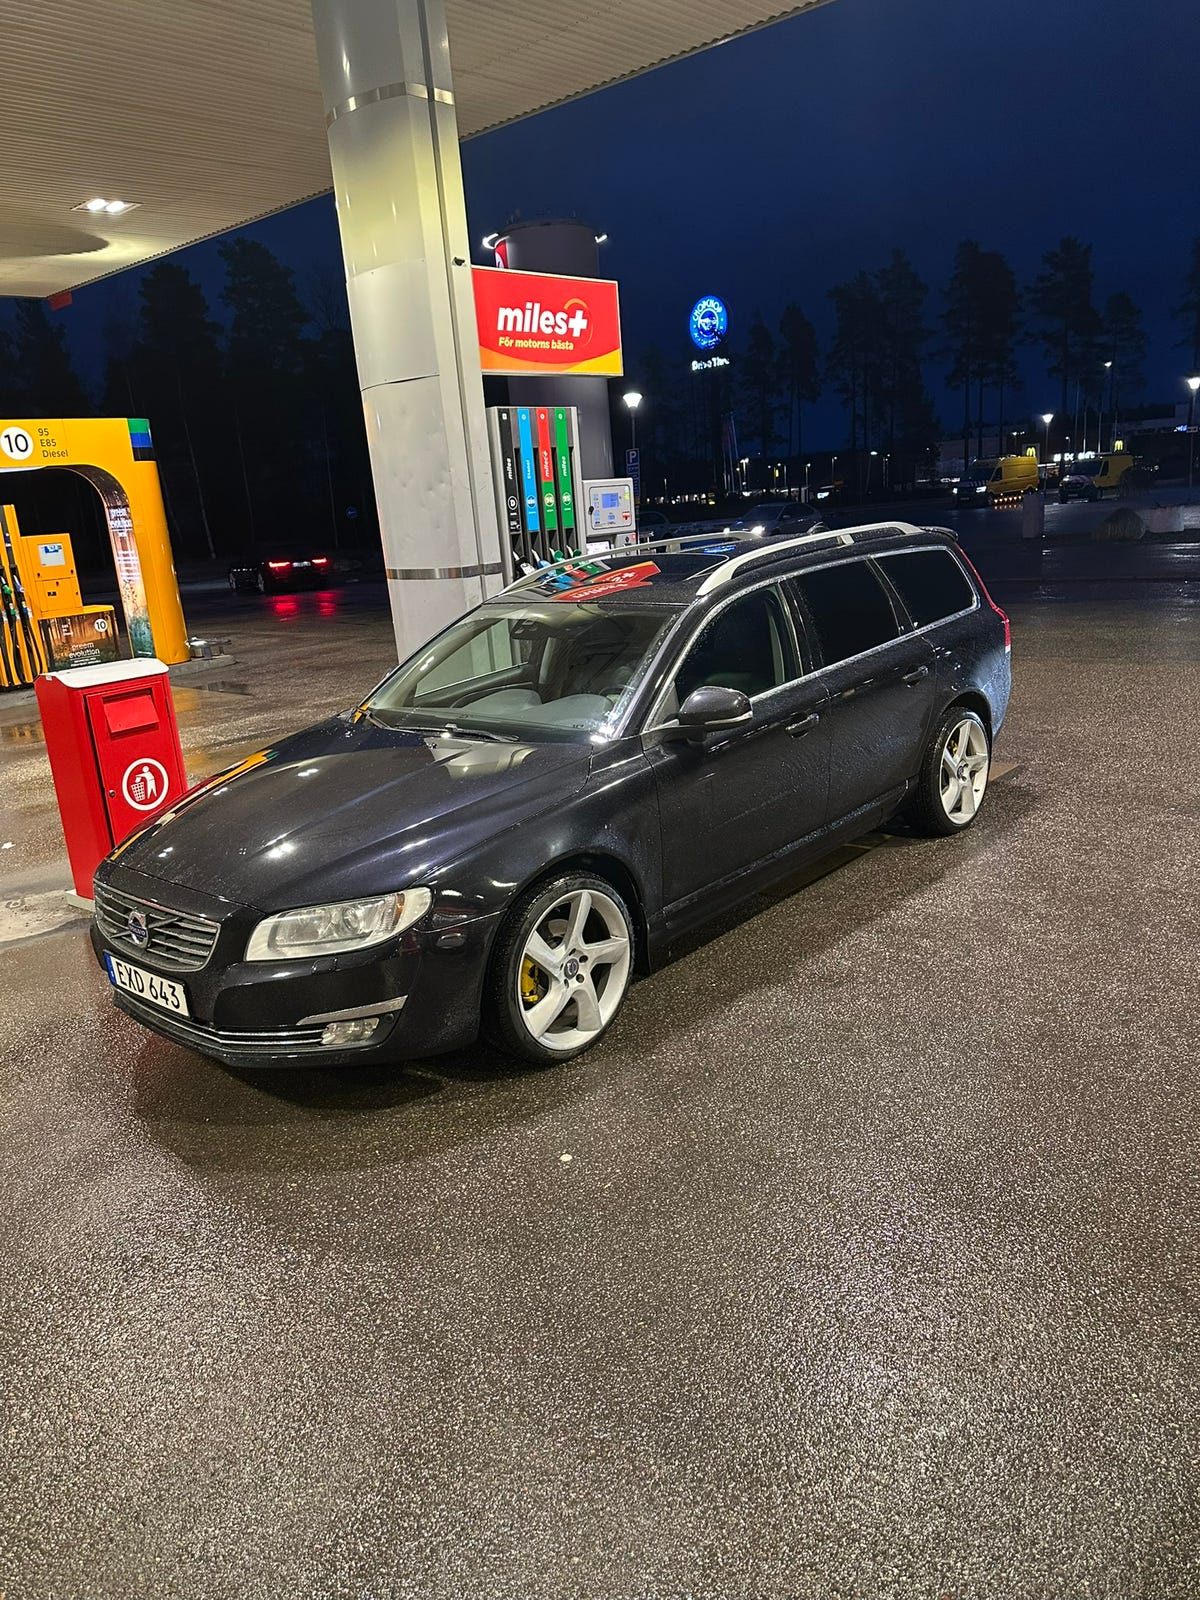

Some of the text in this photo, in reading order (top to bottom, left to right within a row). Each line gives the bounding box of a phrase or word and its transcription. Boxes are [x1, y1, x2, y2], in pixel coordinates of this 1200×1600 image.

[497, 302, 588, 337] miles+
[499, 337, 574, 350] För motorns bästa
[38, 428, 49, 436] 95
[4, 434, 29, 453] 10
[40, 439, 56, 447] E85
[42, 449, 69, 458] Diesel
[629, 451, 637, 463] P
[96, 621, 106, 630] 10
[68, 648, 100, 659] evolution
[115, 961, 180, 1009] EXD 643
